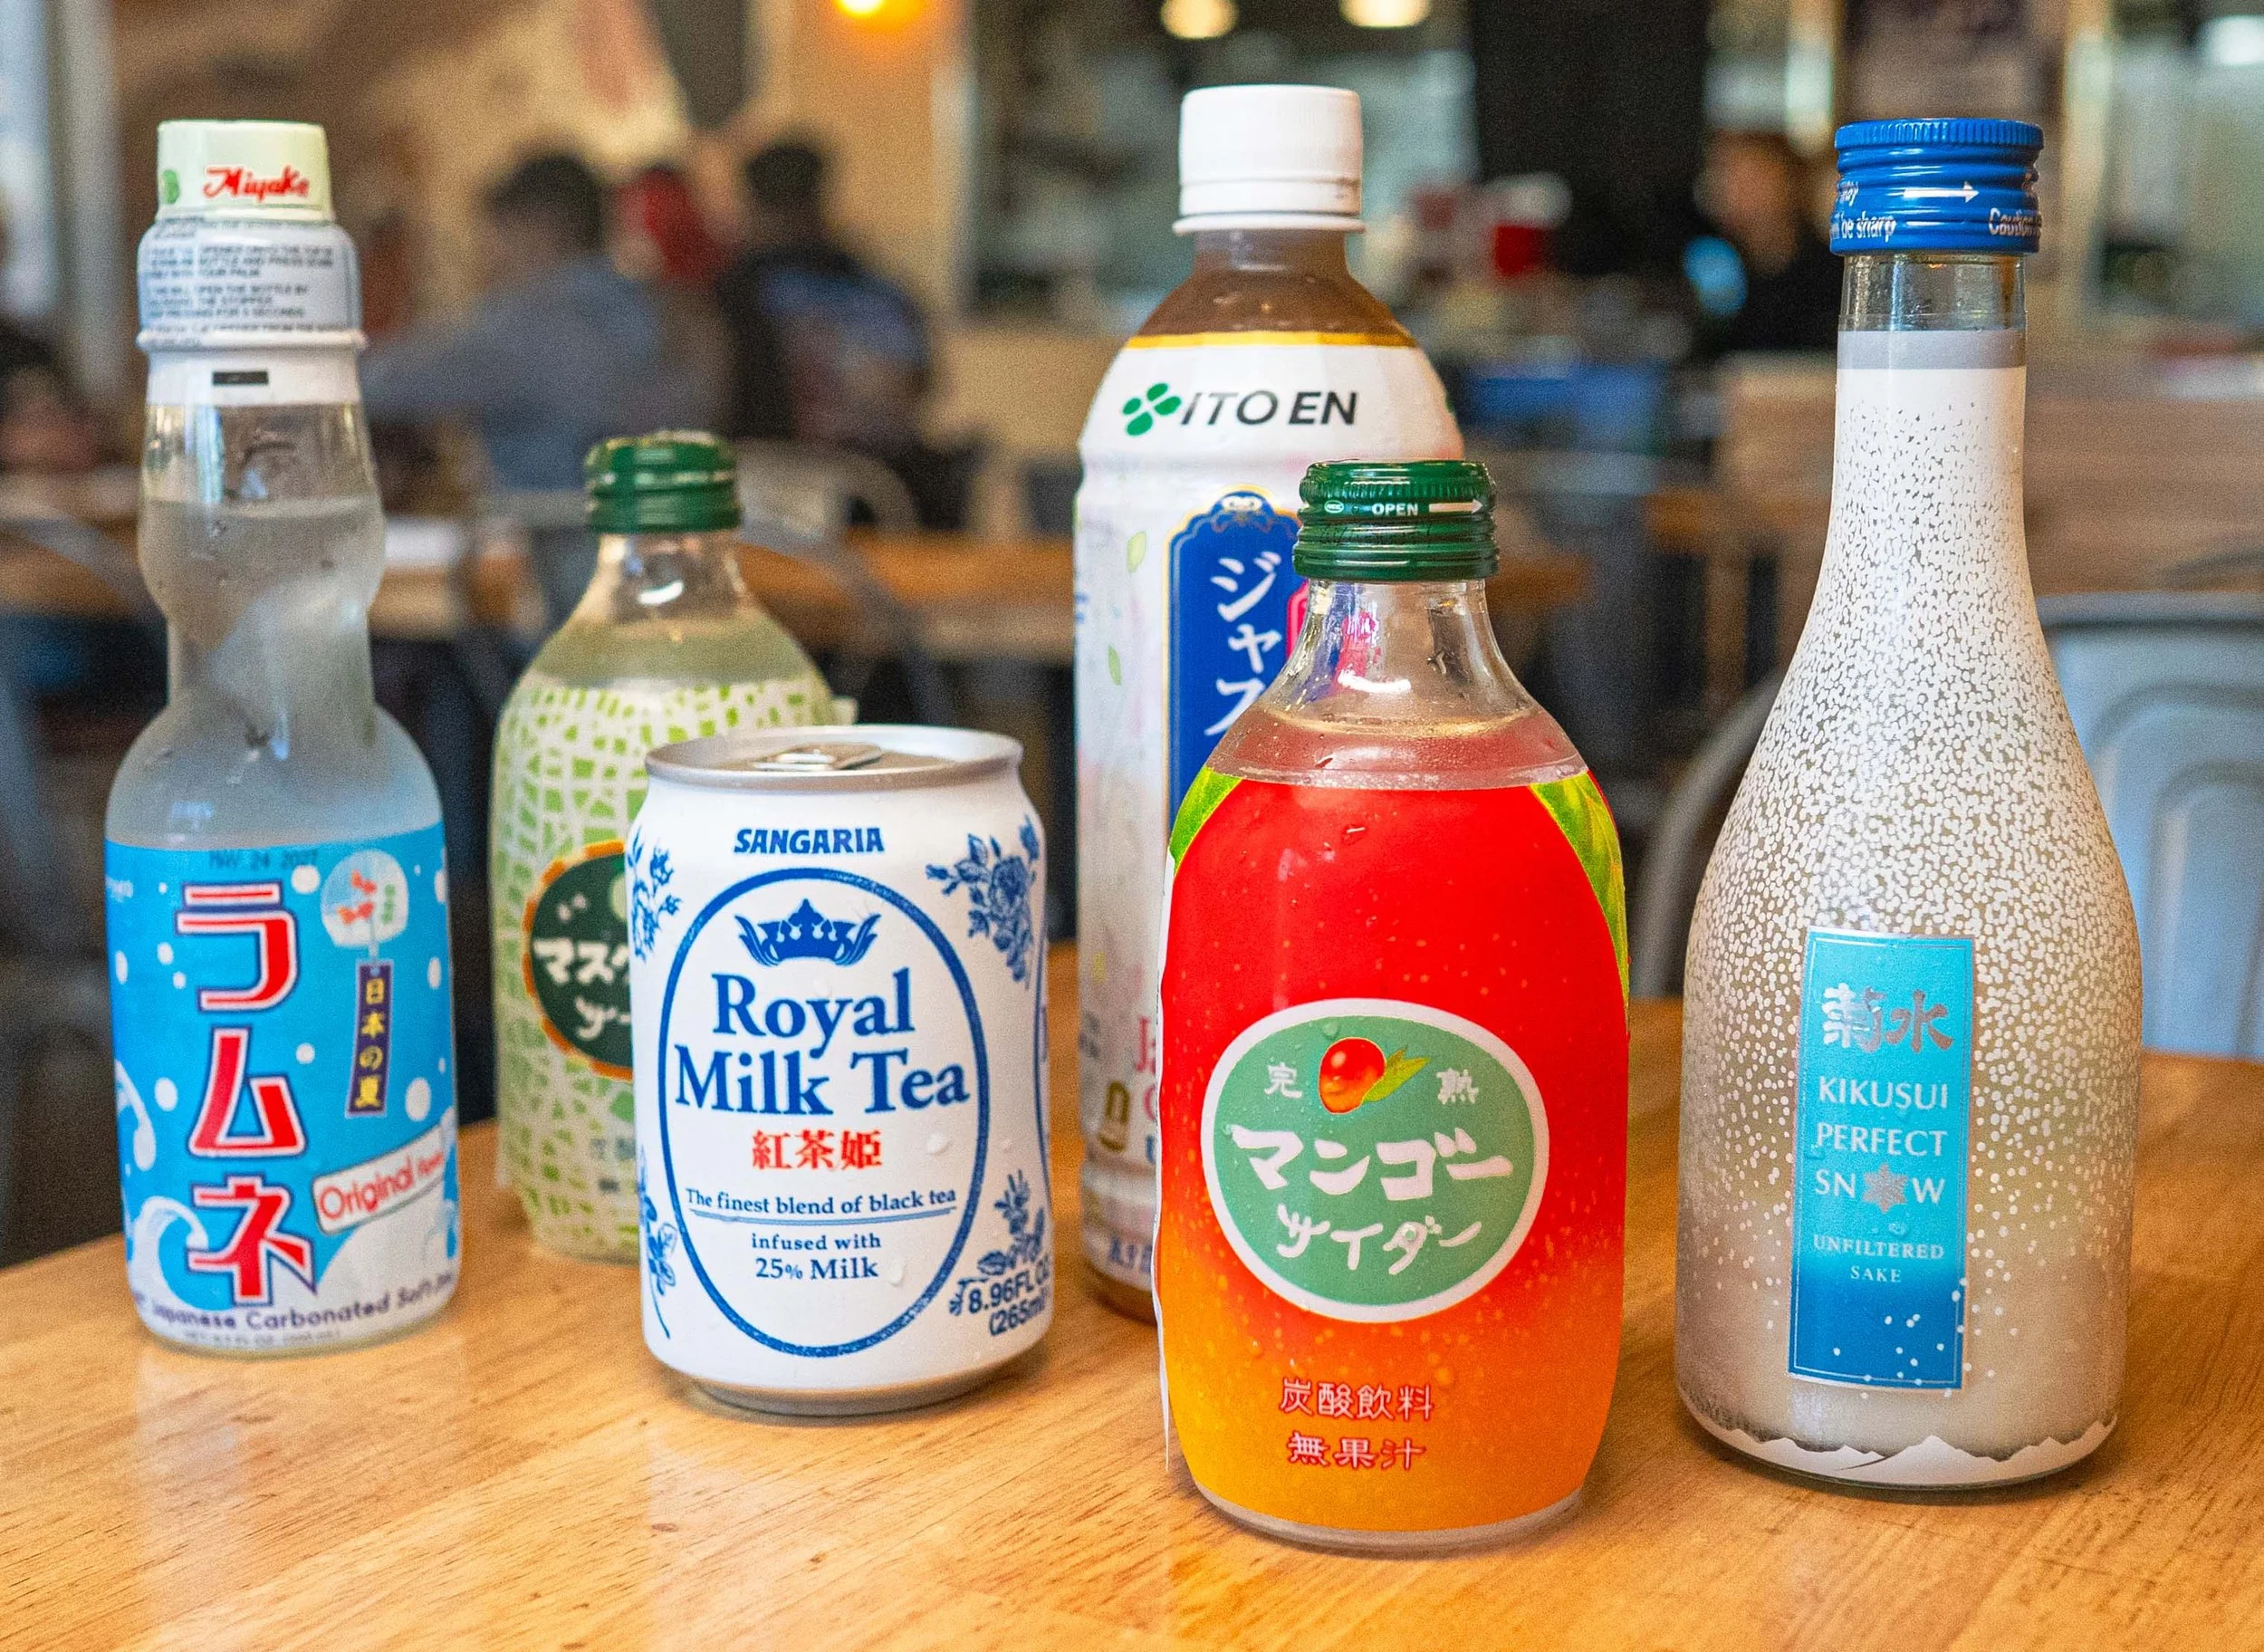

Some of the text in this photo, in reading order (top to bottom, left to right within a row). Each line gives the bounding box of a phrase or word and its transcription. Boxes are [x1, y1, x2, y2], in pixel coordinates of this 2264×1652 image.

[1856, 210, 1897, 242] sharp
[1181, 390, 1357, 425] ITO EN
[1371, 503, 1418, 516] OPEN
[734, 827, 885, 854] SANGARIA
[711, 967, 915, 1058] Royal
[1821, 983, 1954, 1054] 菊水
[175, 881, 317, 1306] ラムネ
[674, 1043, 970, 1115] Milk Tea
[1264, 1061, 1479, 1105] 完 熟
[1818, 1076, 1948, 1109] KIKUSUI
[752, 1129, 882, 1171] 紅茶姫
[1816, 1122, 1948, 1157] PERFECT
[1231, 1125, 1513, 1201] マンゴー
[319, 1155, 415, 1220] Original
[686, 1188, 956, 1215] The finest blend of black tea
[752, 1233, 882, 1251] infused with
[1277, 1204, 1482, 1275] サイダー
[1813, 1234, 1945, 1260] UNFILTERED
[755, 1256, 878, 1280] 25% Milk
[1850, 1264, 1902, 1283] SAKE
[246, 1292, 390, 1330] Carbonated
[1280, 1377, 1434, 1420] 炭酸飲料
[1287, 1430, 1427, 1471] 無果汁
